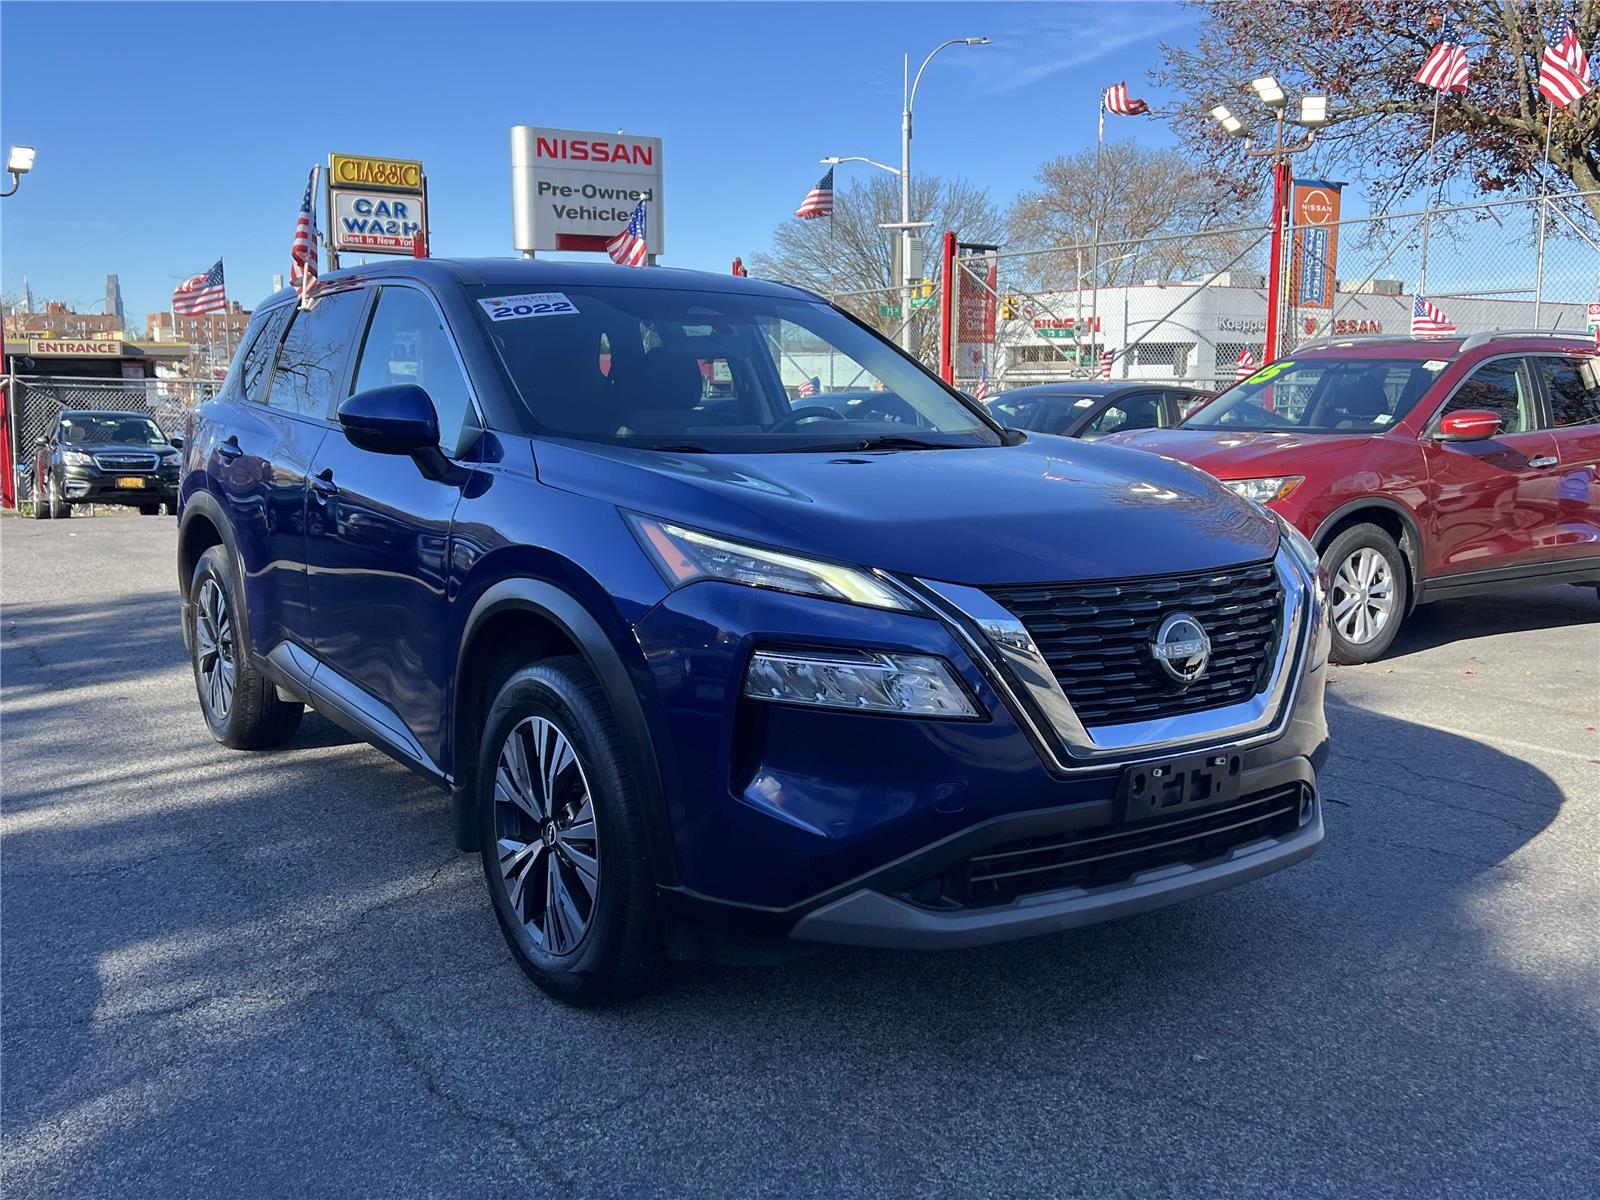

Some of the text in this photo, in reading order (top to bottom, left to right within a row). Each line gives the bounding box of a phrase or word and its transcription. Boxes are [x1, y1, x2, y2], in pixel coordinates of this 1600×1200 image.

[536, 137, 653, 166] NISSAN
[339, 160, 419, 187] CLASSIC
[538, 181, 654, 202] Pre-Owned
[352, 198, 408, 219] CAR
[1301, 203, 1333, 214] NISSAN
[343, 234, 363, 243] Best
[377, 237, 396, 247] New
[399, 239, 415, 248] Yor
[492, 302, 573, 319] 2022
[1034, 316, 1101, 333] NISSN
[1217, 316, 1266, 335] Koeppe
[1331, 319, 1383, 335] ISSAN
[37, 342, 116, 353] ENTRANCE
[1154, 637, 1209, 658] NISSAN
